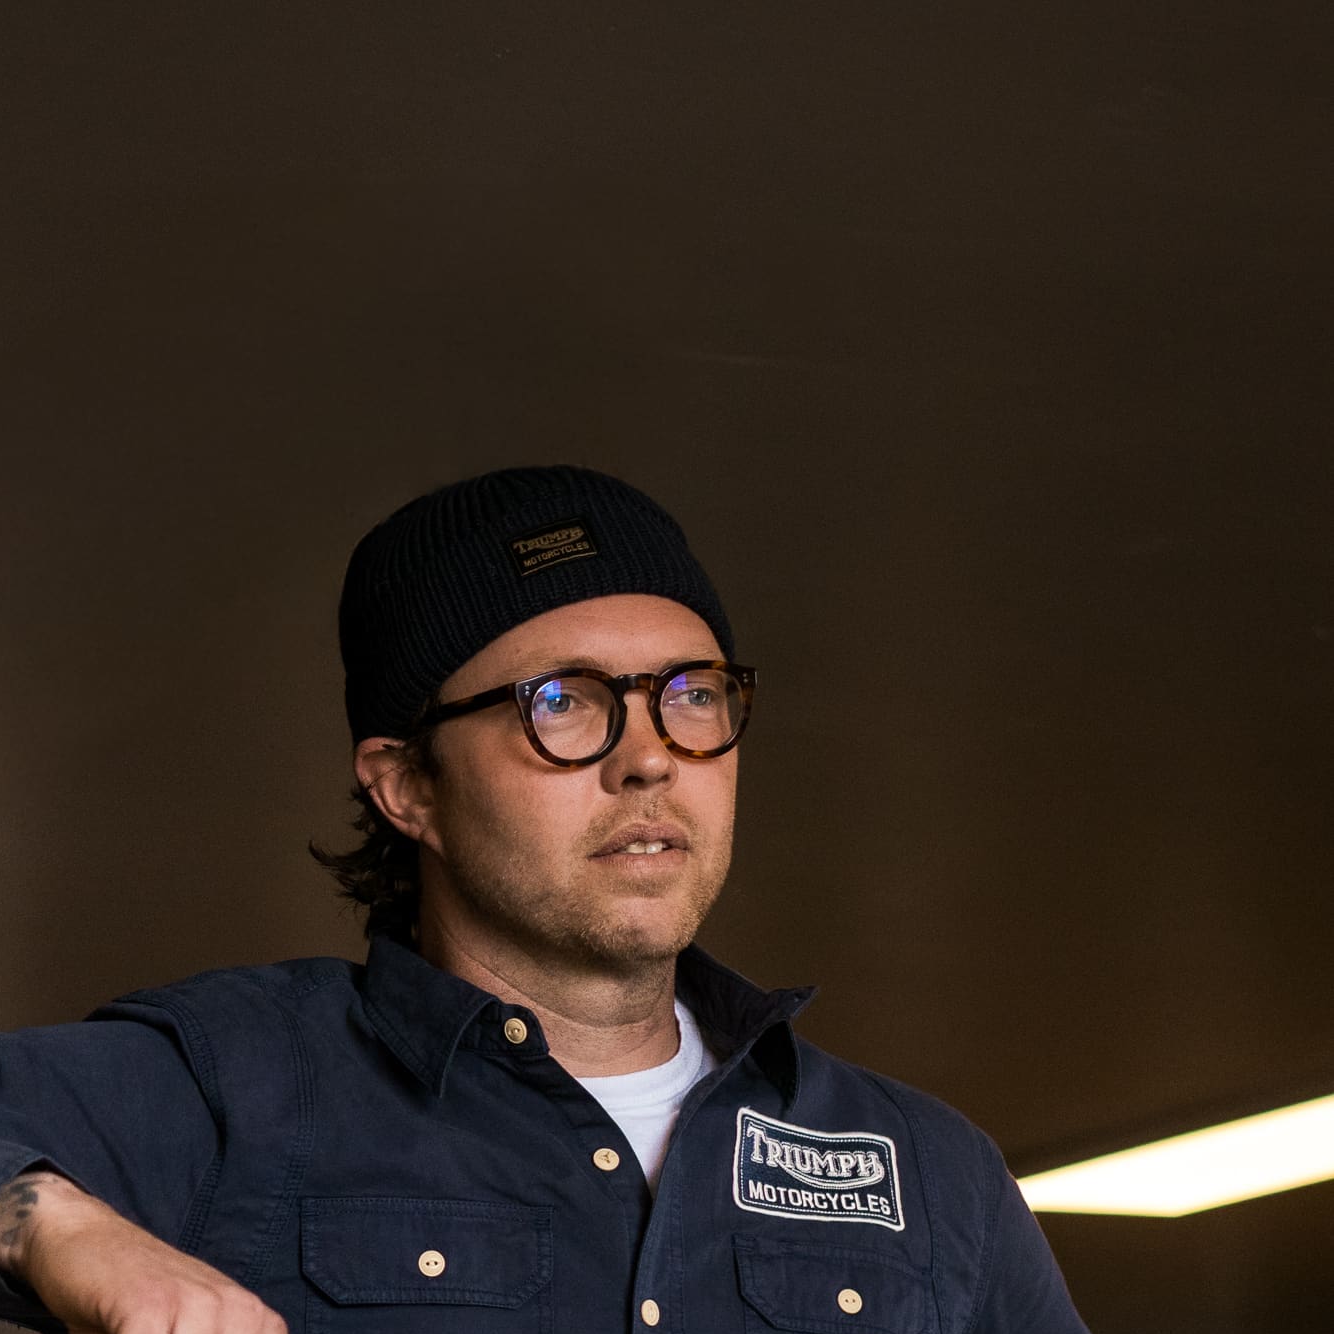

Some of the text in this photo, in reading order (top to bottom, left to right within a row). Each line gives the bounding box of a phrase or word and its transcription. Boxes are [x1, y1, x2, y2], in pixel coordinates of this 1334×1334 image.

[523, 541, 590, 567] MOTORCYCLES
[747, 1121, 885, 1185] TRIUMPH
[748, 1179, 892, 1216] MOTORCYCLES
